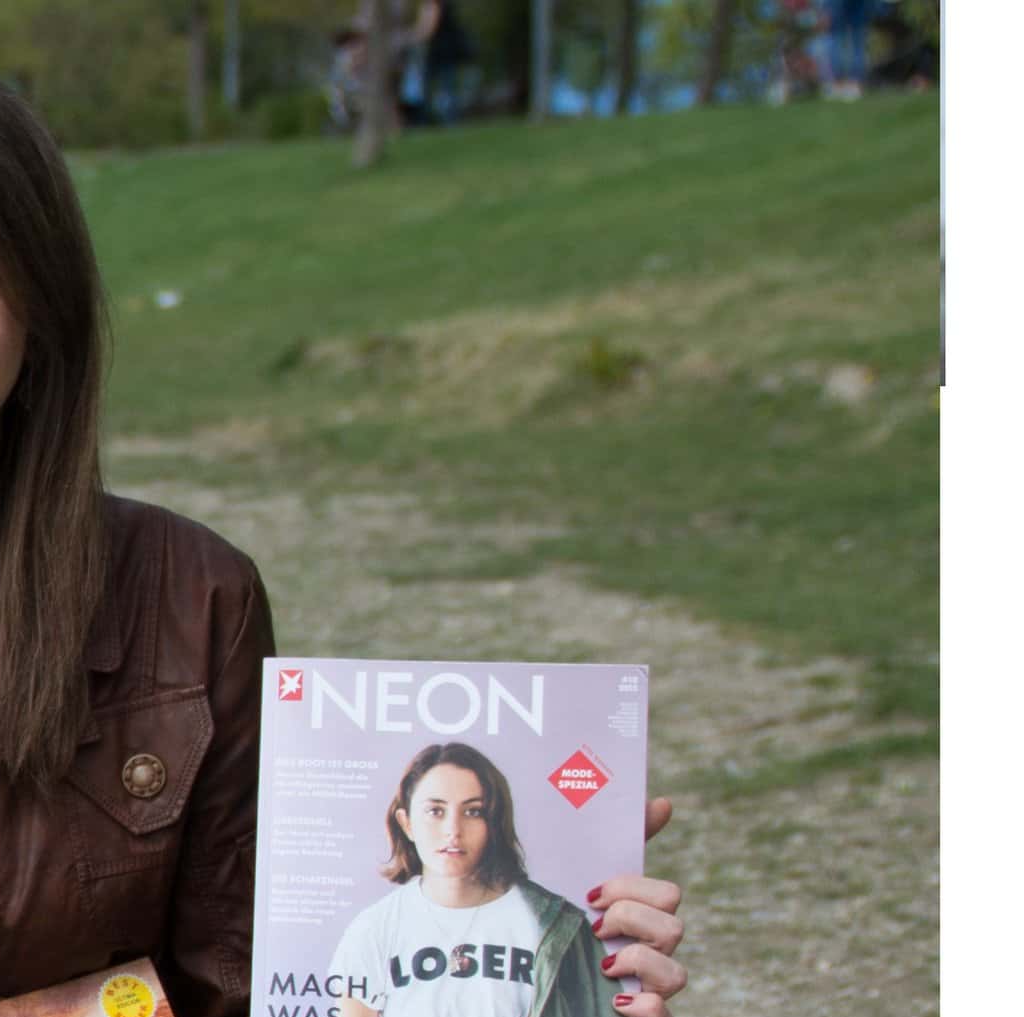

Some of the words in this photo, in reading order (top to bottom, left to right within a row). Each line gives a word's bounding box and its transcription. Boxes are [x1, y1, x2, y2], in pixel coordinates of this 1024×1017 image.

[311, 669, 545, 736] NEON
[557, 780, 599, 790] SPEZIAL
[561, 769, 596, 778] MODE-
[390, 943, 536, 988] LOSER
[269, 972, 377, 1004] MACH,
